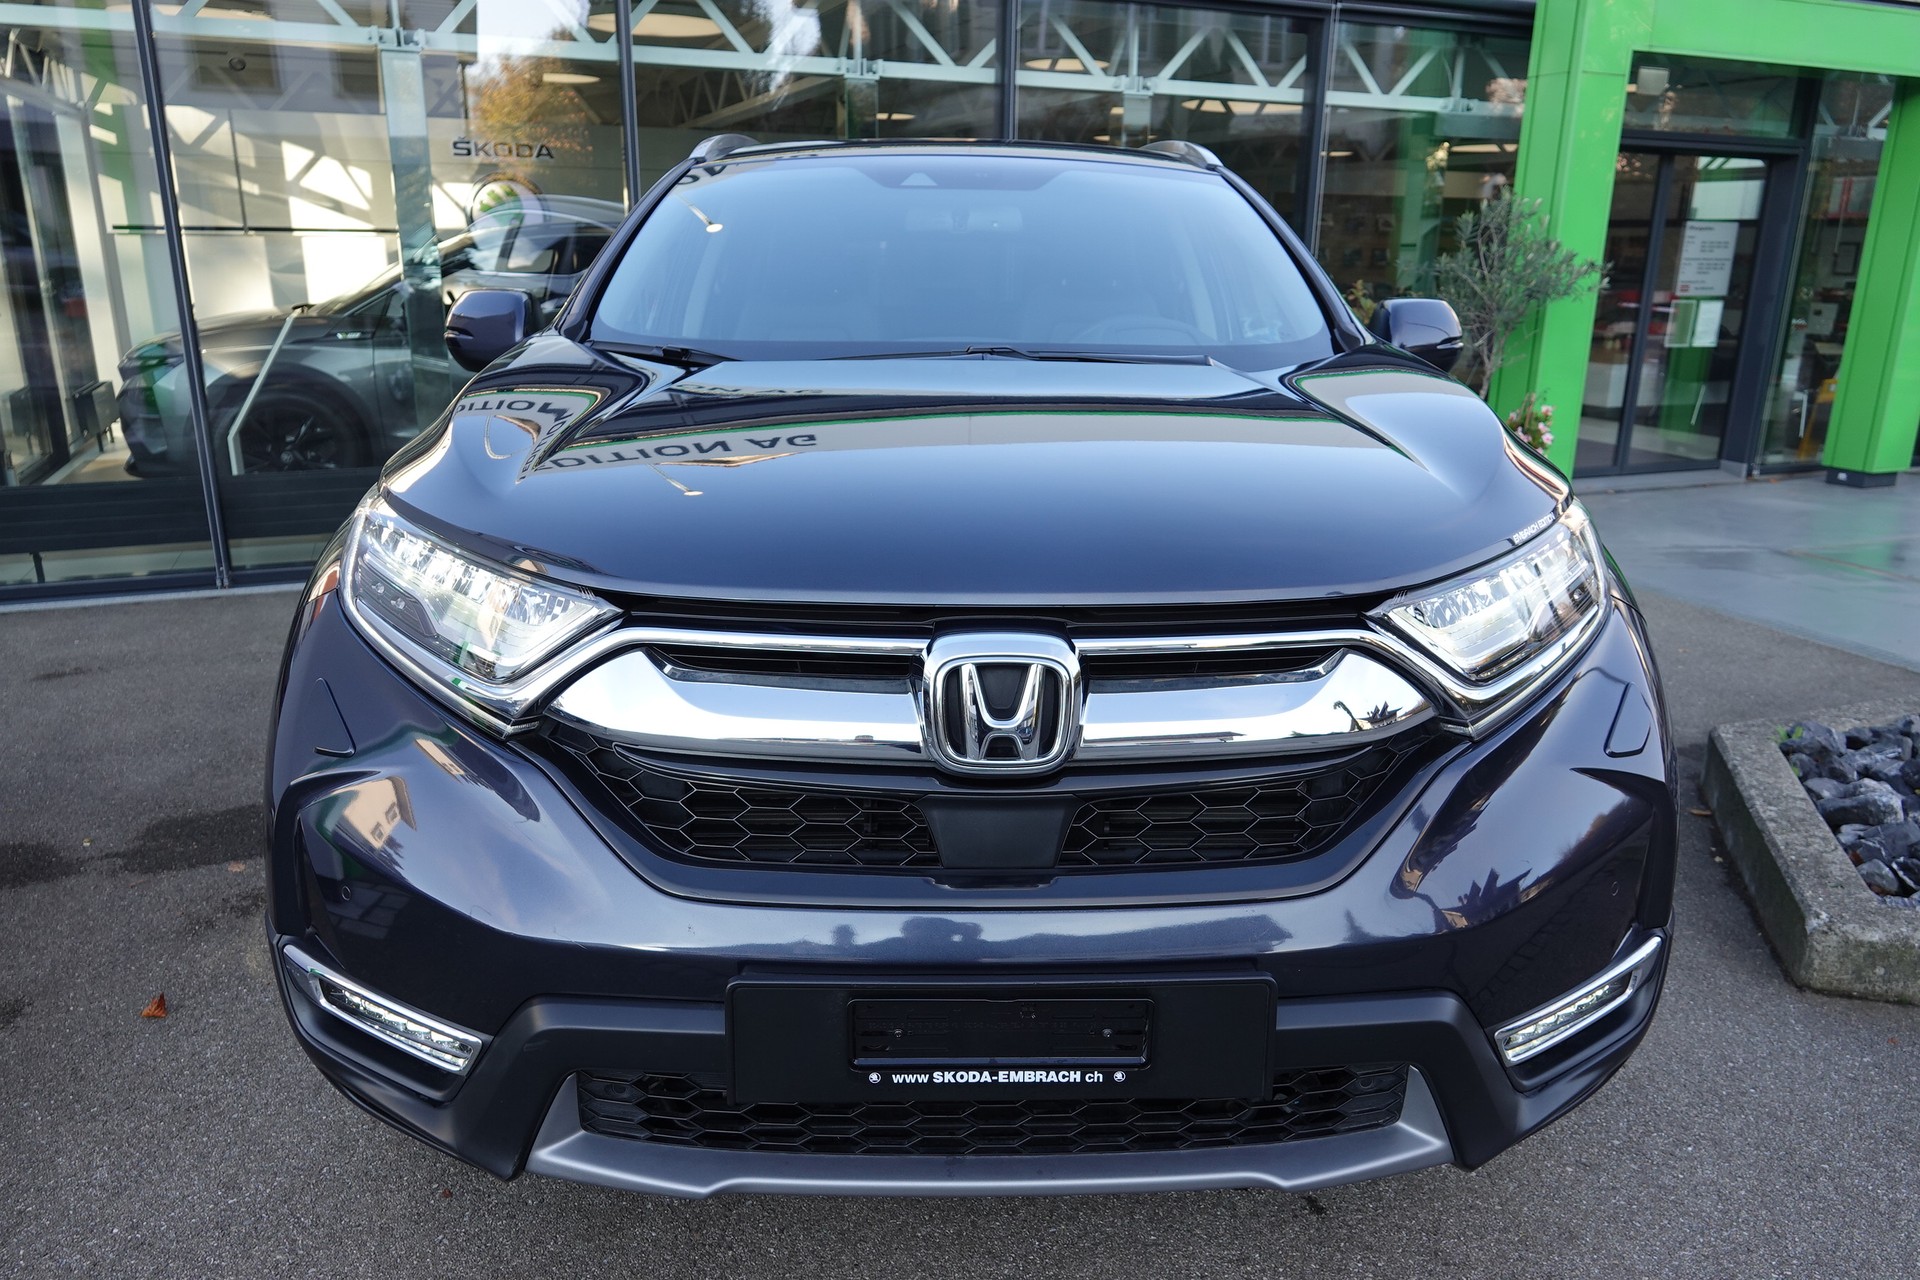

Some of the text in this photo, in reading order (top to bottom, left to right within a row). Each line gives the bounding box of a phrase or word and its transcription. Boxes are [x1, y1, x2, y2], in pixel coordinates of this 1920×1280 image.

[453, 136, 554, 159] ŠKODA
[933, 1071, 1081, 1083] SKODA-EMBRACH
[1085, 1071, 1103, 1083] ch
